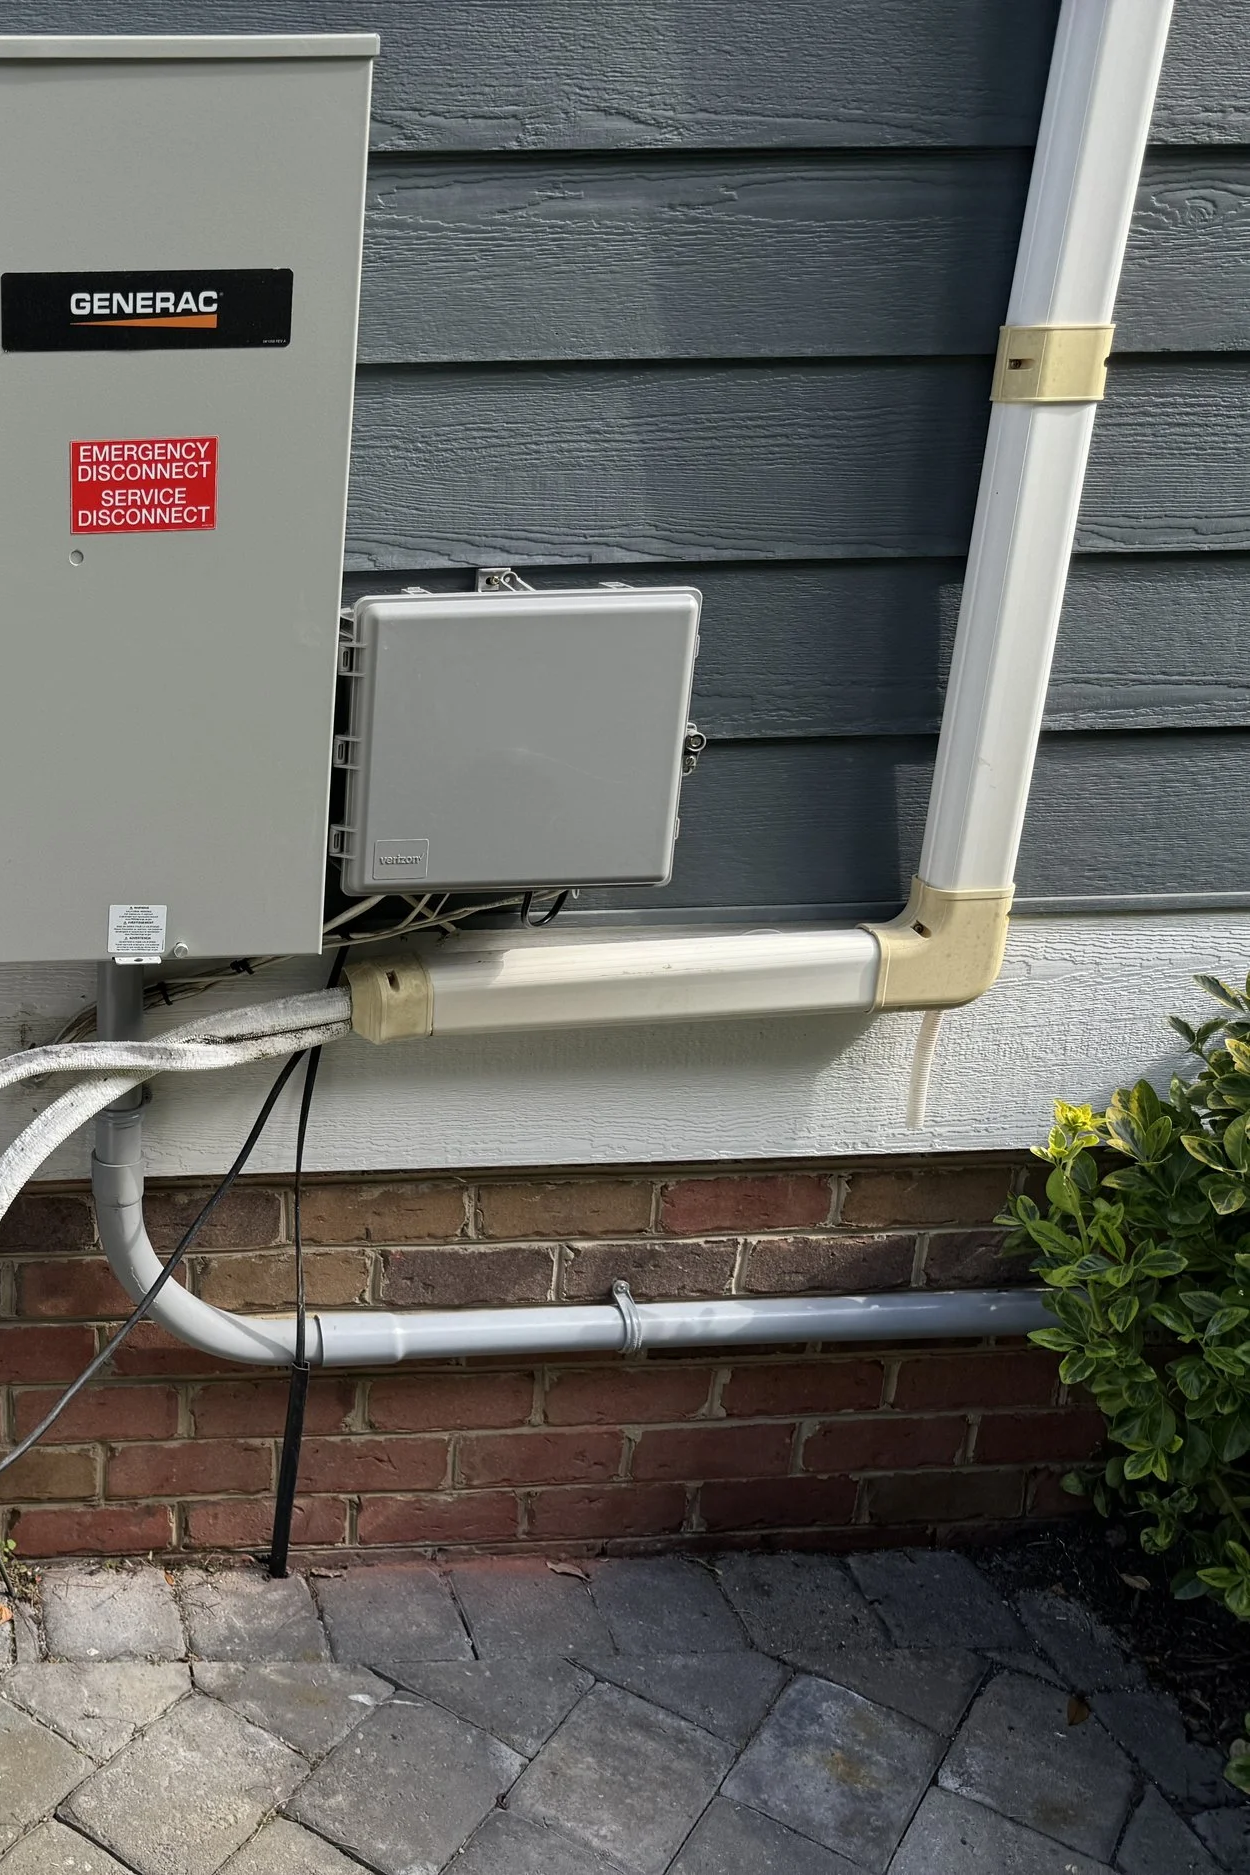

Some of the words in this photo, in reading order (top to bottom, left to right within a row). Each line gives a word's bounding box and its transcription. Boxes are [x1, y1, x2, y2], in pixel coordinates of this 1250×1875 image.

[70, 291, 218, 315] GENERAC
[79, 441, 210, 462] EMERGENCY
[78, 461, 211, 482] DISCONNECT
[101, 488, 187, 506] SERVICE
[78, 506, 210, 527] DISCONNECT
[379, 853, 422, 866] verizon
